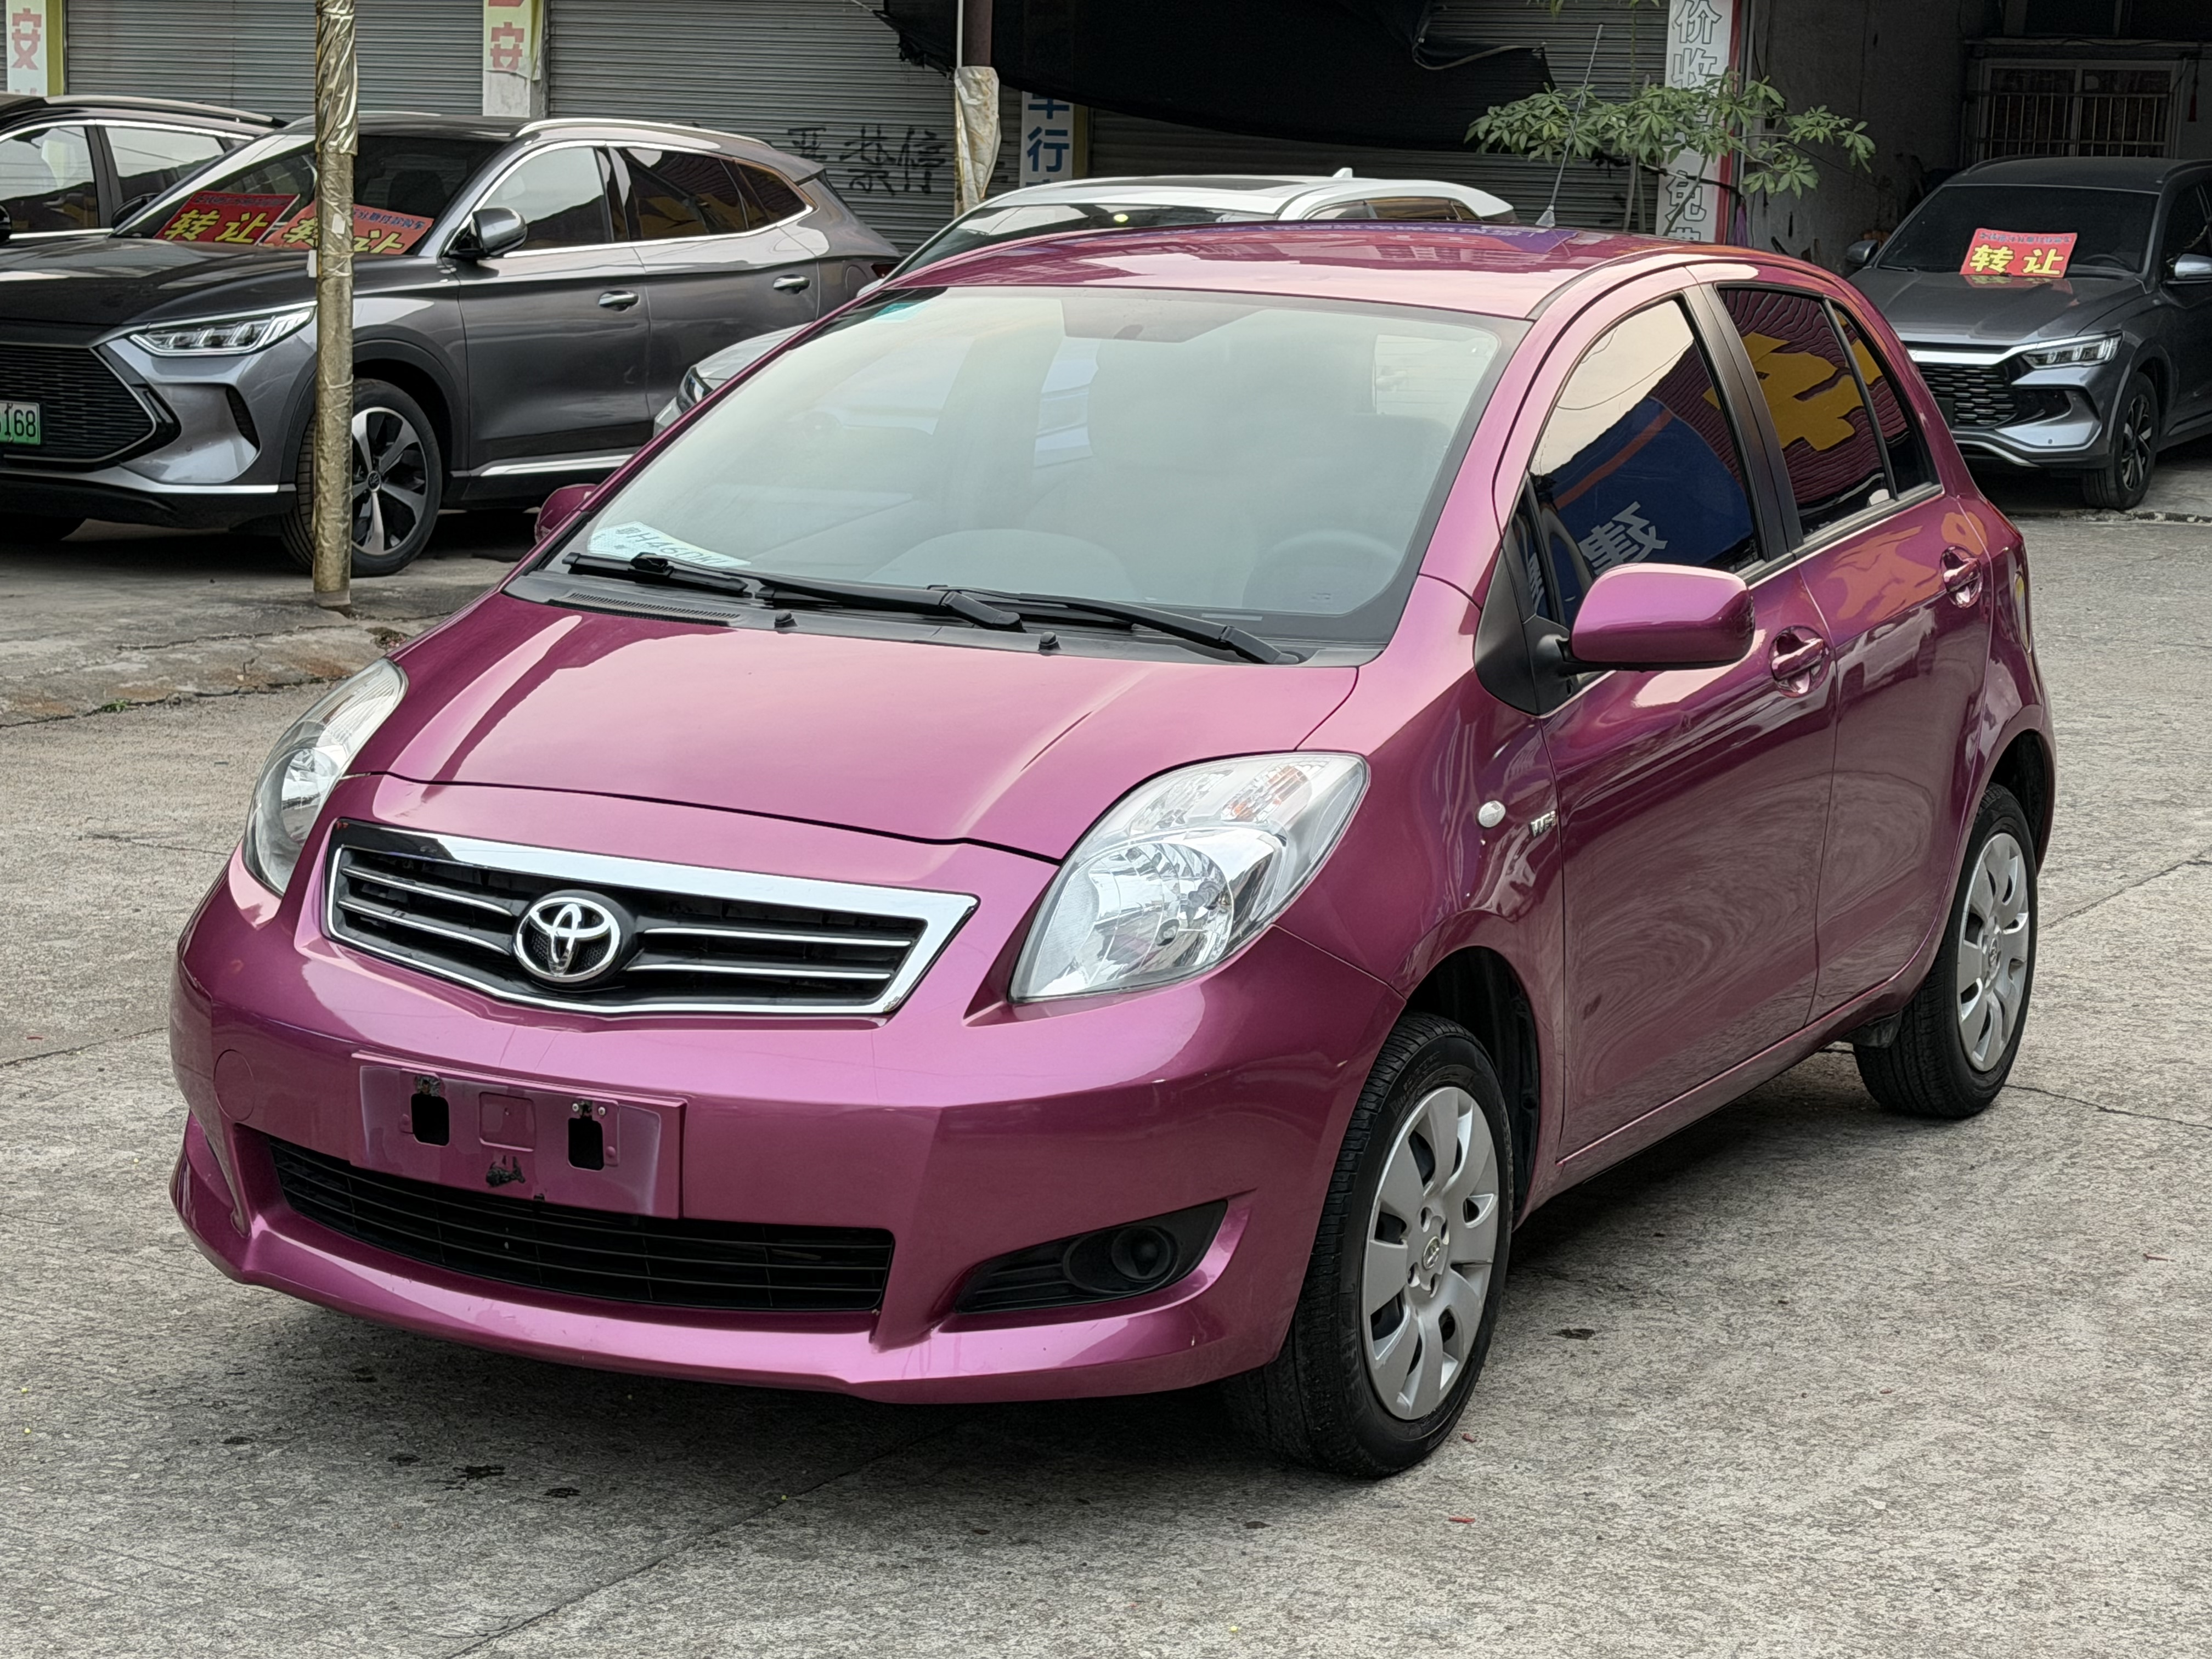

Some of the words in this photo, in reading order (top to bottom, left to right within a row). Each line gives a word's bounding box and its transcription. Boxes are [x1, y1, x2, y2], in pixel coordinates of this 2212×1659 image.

[11, 8, 42, 94] 安
[489, 0, 525, 71] 安
[1027, 93, 1070, 185] 车行
[166, 209, 269, 243] 转让
[1969, 244, 2064, 274] 转让
[0, 409, 36, 437] 168
